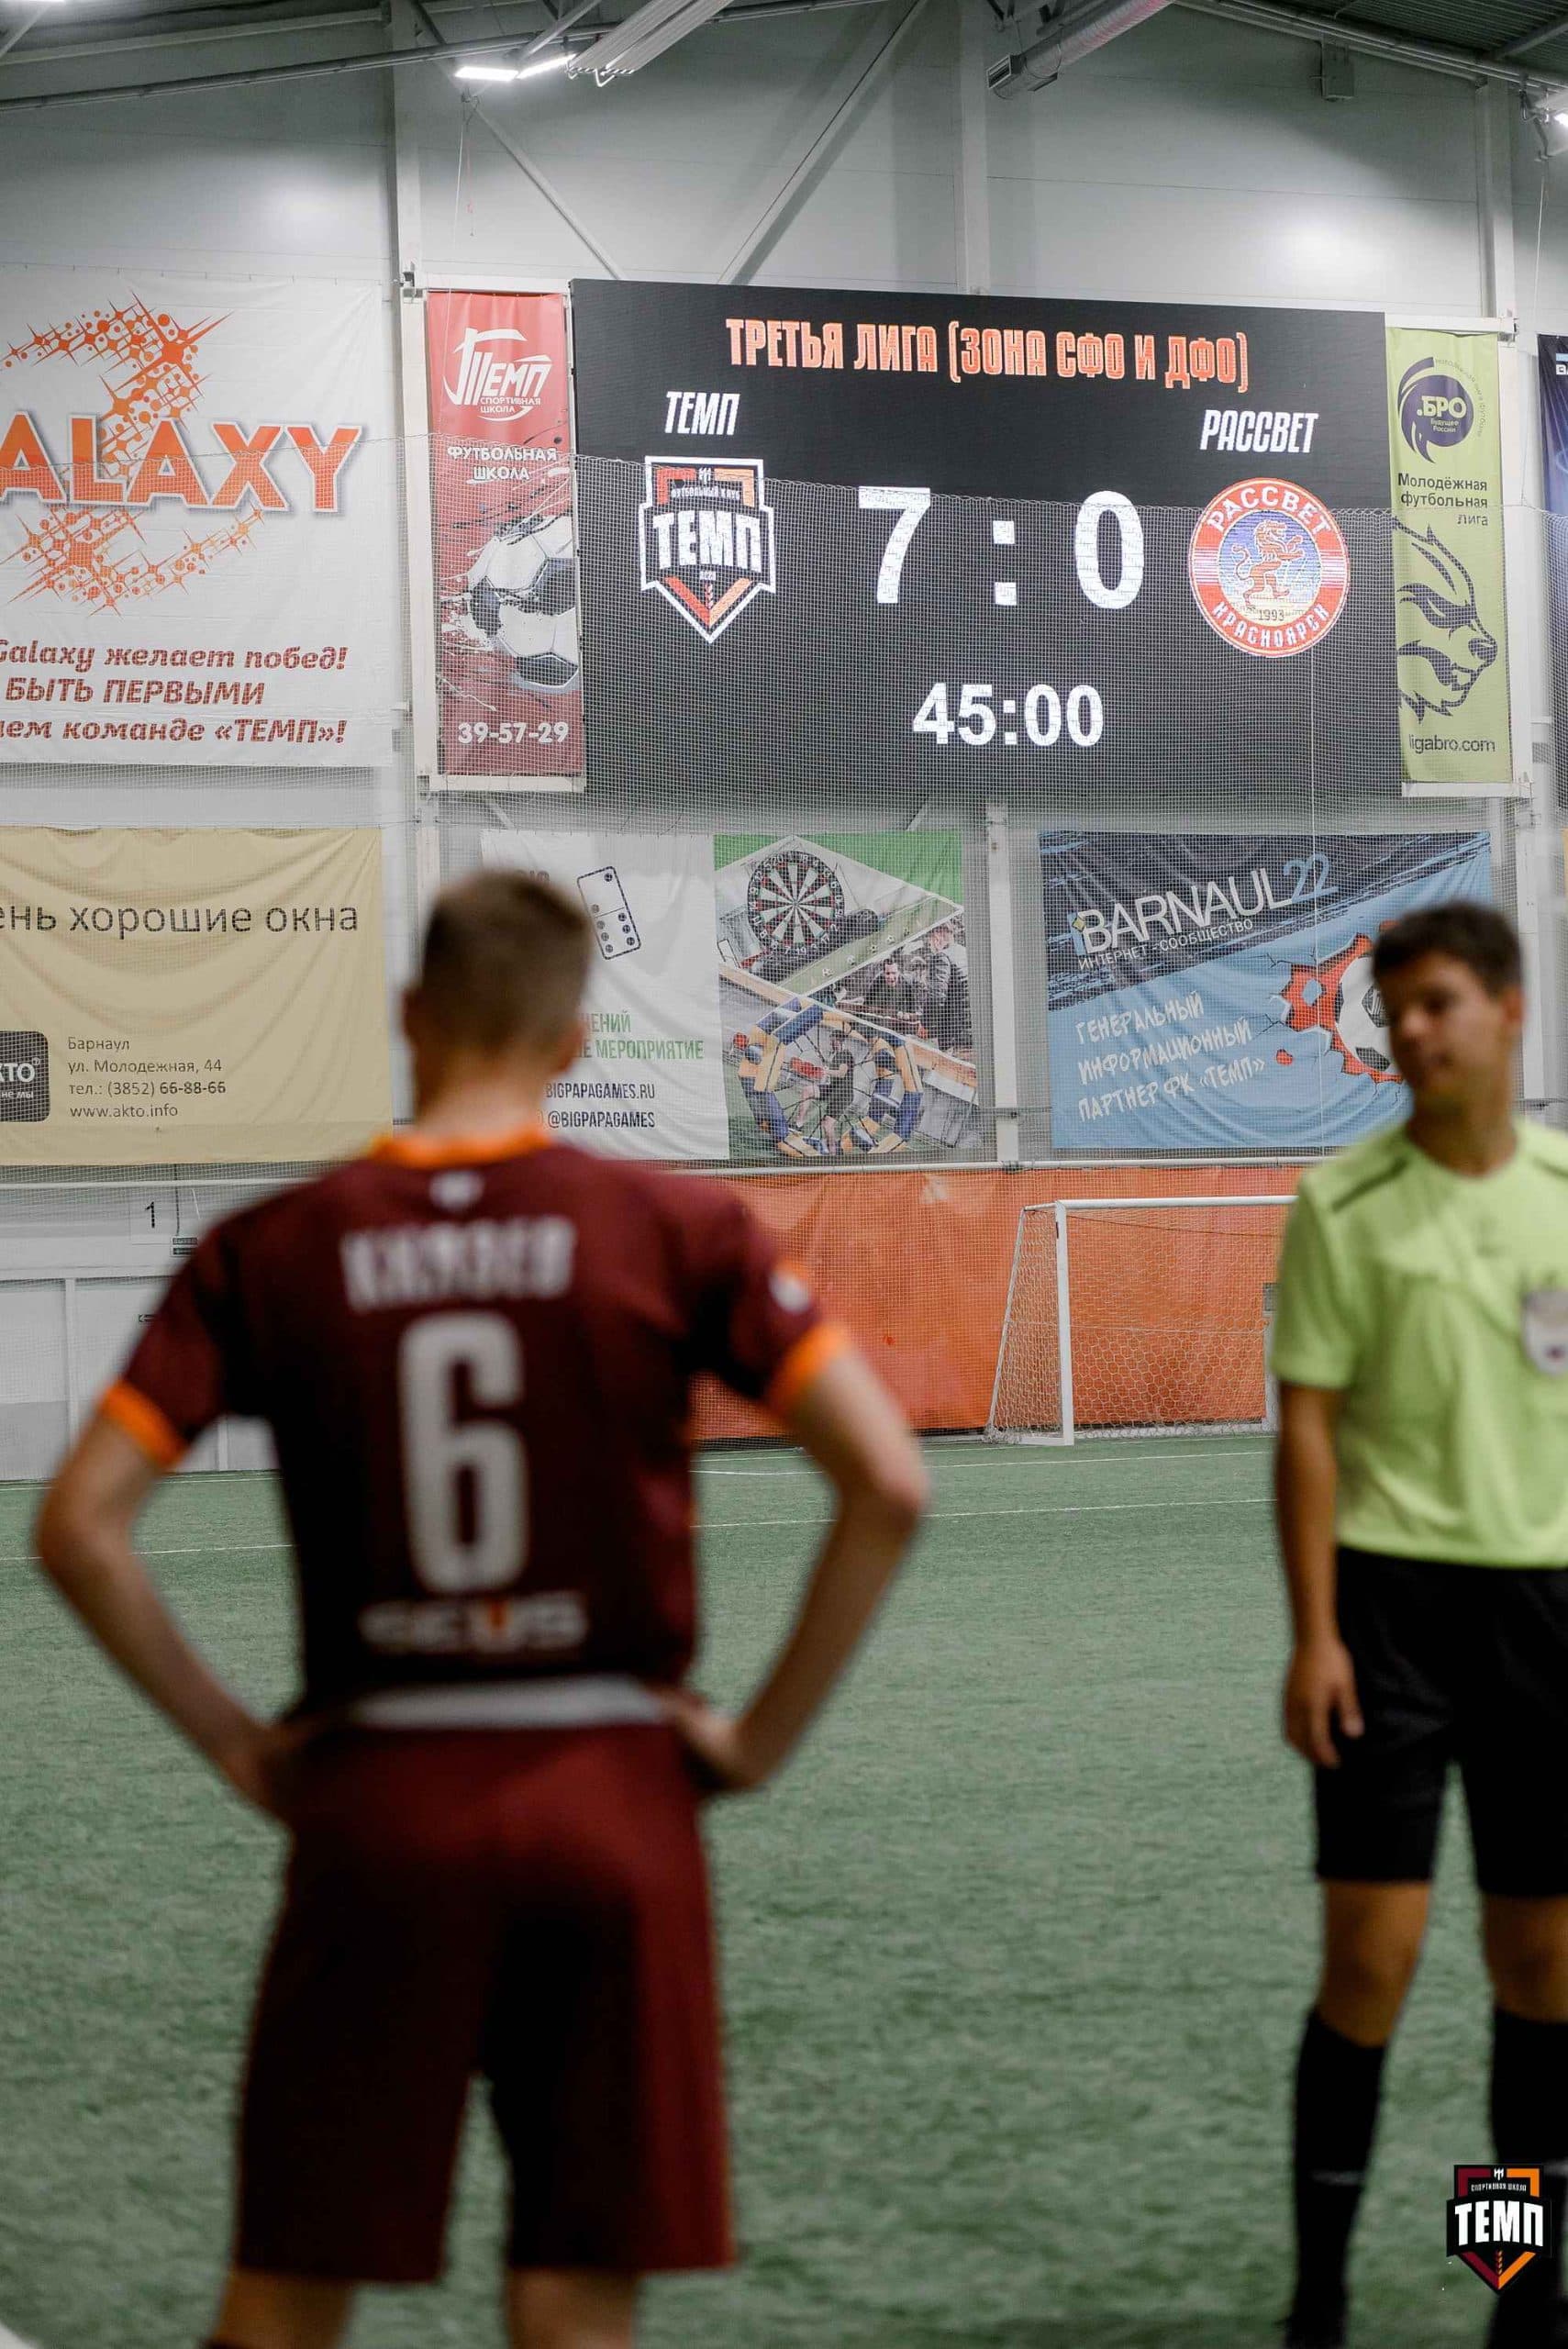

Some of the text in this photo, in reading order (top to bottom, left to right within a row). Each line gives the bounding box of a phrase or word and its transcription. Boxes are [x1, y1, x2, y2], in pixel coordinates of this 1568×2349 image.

[726, 318, 1249, 393] ТРЕТЬЯ ЛИГА (ЗОНА СФО И ДФО)
[480, 396, 541, 406] СПОРТИВНАЯ
[480, 406, 516, 414] ШКОЛА
[664, 391, 740, 436] ТЕМП
[1199, 409, 1319, 453] РАССВЕТ
[447, 446, 557, 461] ФУТБОЛЬНАЯ
[473, 466, 530, 480] ШКОЛА
[1397, 473, 1487, 491] Молодёжная
[1207, 485, 1331, 535] РАССВЕТ
[1400, 491, 1488, 507] футбольная
[652, 510, 761, 573] ТЕМП
[858, 486, 930, 604] 7
[1075, 490, 1144, 609] 0
[1212, 601, 1329, 648] КРАСНОЯРСК
[1258, 607, 1284, 622] 1993
[104, 646, 235, 668] желает
[243, 646, 348, 670] побед!
[6, 677, 265, 705] БЫТЬ ПЕРВЫМИ
[913, 682, 1104, 747] 45:00
[0, 718, 348, 743] ем команде «ТЕМП»!
[458, 721, 570, 743] 39-57-29
[1409, 734, 1496, 754] ligabro.com
[0, 906, 359, 941] нь хорошие окна
[1075, 990, 1204, 1044] ГЕНЕРАЛЬНЫЙ
[68, 1037, 129, 1052] Барнаул
[596, 1041, 704, 1059] МЕРОПРИЯТИЕ
[1078, 1016, 1252, 1085] ИНФОРМАЦИОННЫЙ
[69, 1059, 221, 1074] ул. Молодежная, 44
[69, 1081, 226, 1097] тел.: (3852) 66-88-66
[547, 1083, 655, 1099] BIGPAPAGAMES.RU
[1078, 1056, 1265, 1122] ПАРТНЕР ФК «ТЕМП»
[70, 1103, 178, 1118] www.akto.info
[548, 1111, 655, 1128] @BIGPAPAGAMES
[145, 1201, 155, 1229] 1
[397, 1310, 530, 1594] 6
